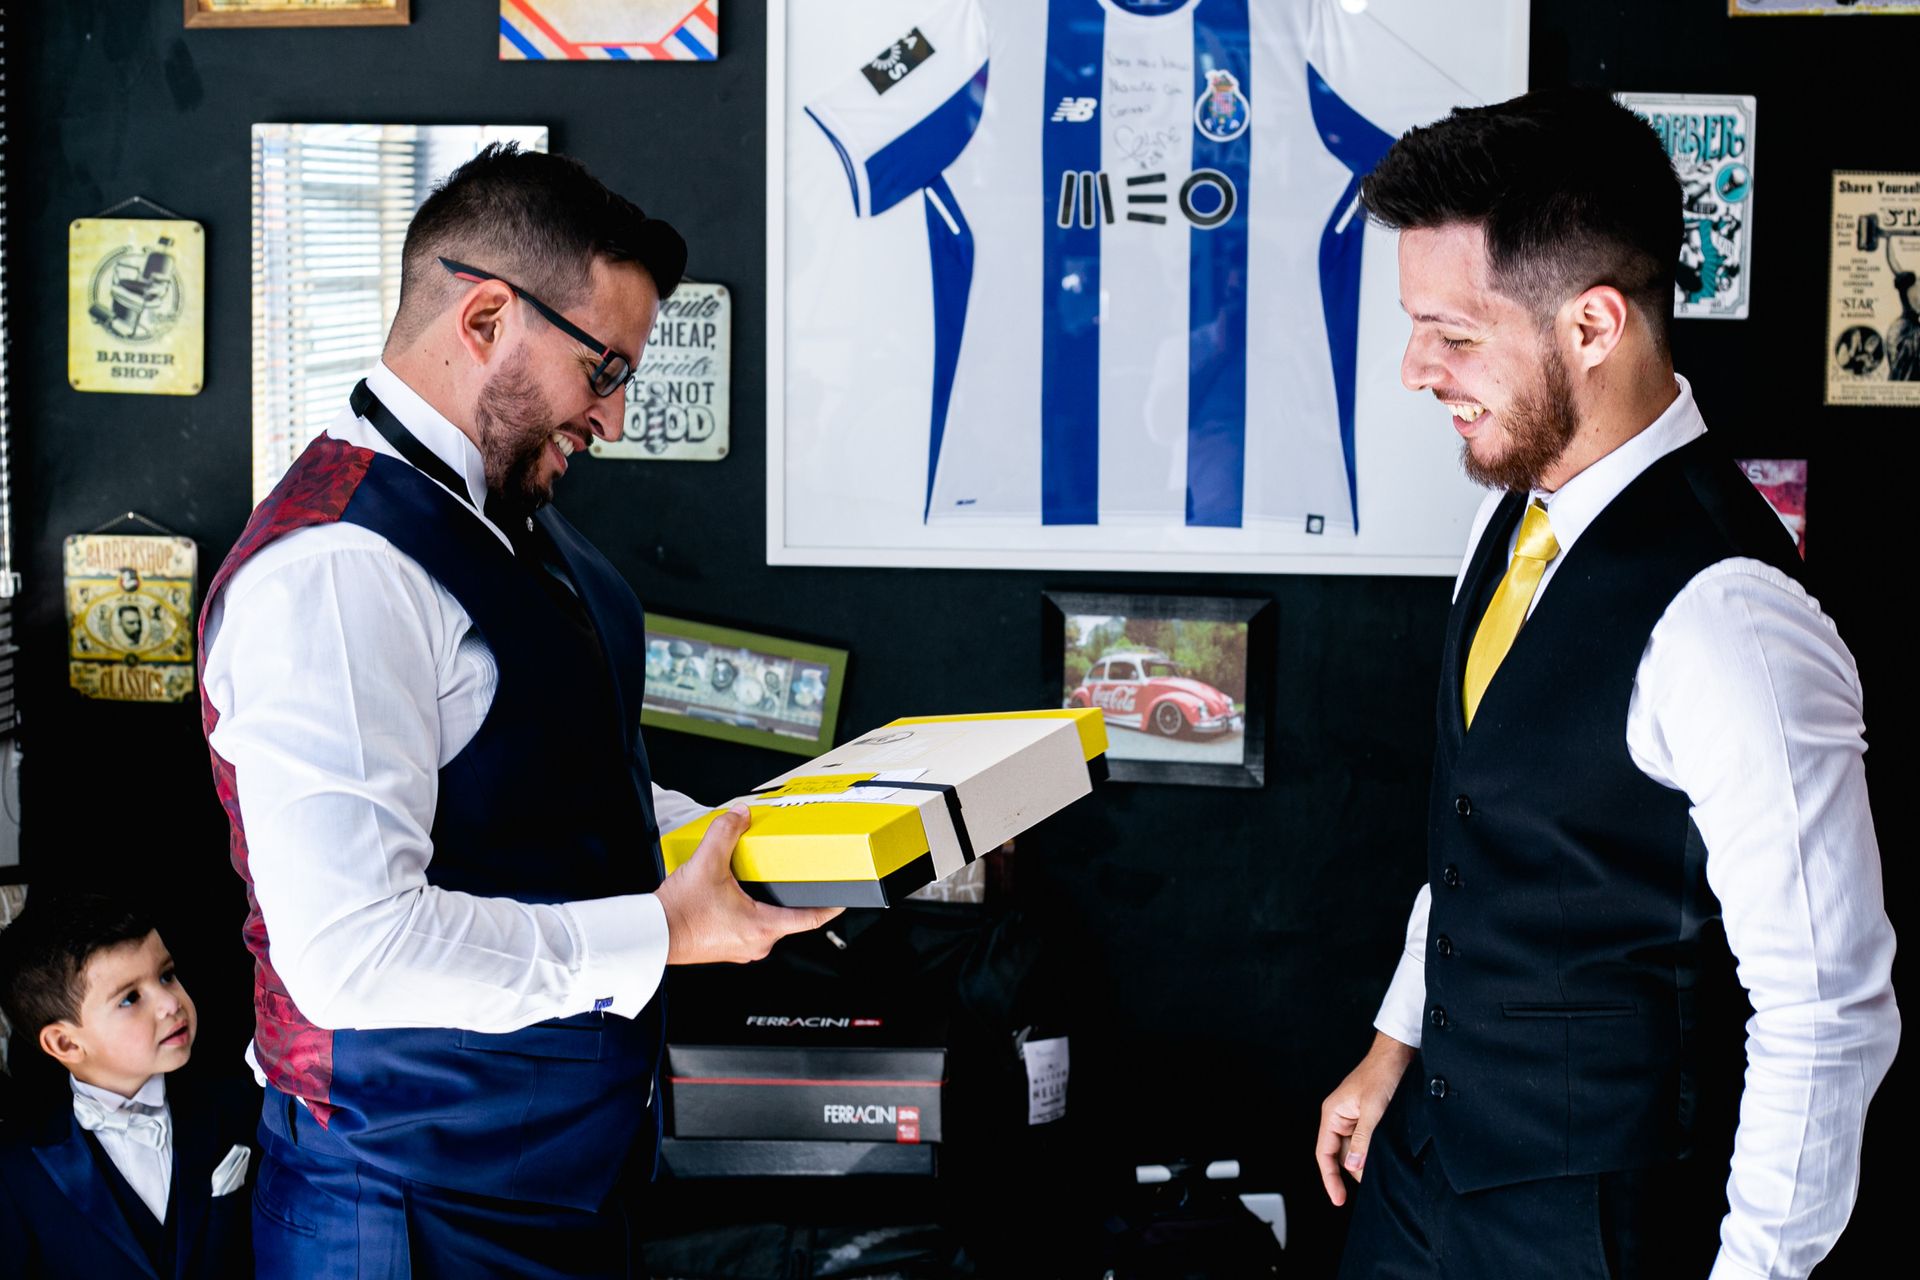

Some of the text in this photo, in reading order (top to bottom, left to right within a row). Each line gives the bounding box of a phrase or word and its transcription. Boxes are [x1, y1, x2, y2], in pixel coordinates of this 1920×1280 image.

[1838, 180, 1873, 193] Shave
[660, 294, 720, 319] cuts
[97, 350, 175, 366] BARBER
[110, 366, 160, 380] SHOP
[668, 381, 715, 405] NOT
[622, 404, 716, 443] OOD
[85, 539, 174, 572] BARBERSHOP
[100, 671, 165, 698] CLASSICS
[746, 1016, 850, 1028] FERRACINI
[823, 1104, 897, 1125] FERRACINI
